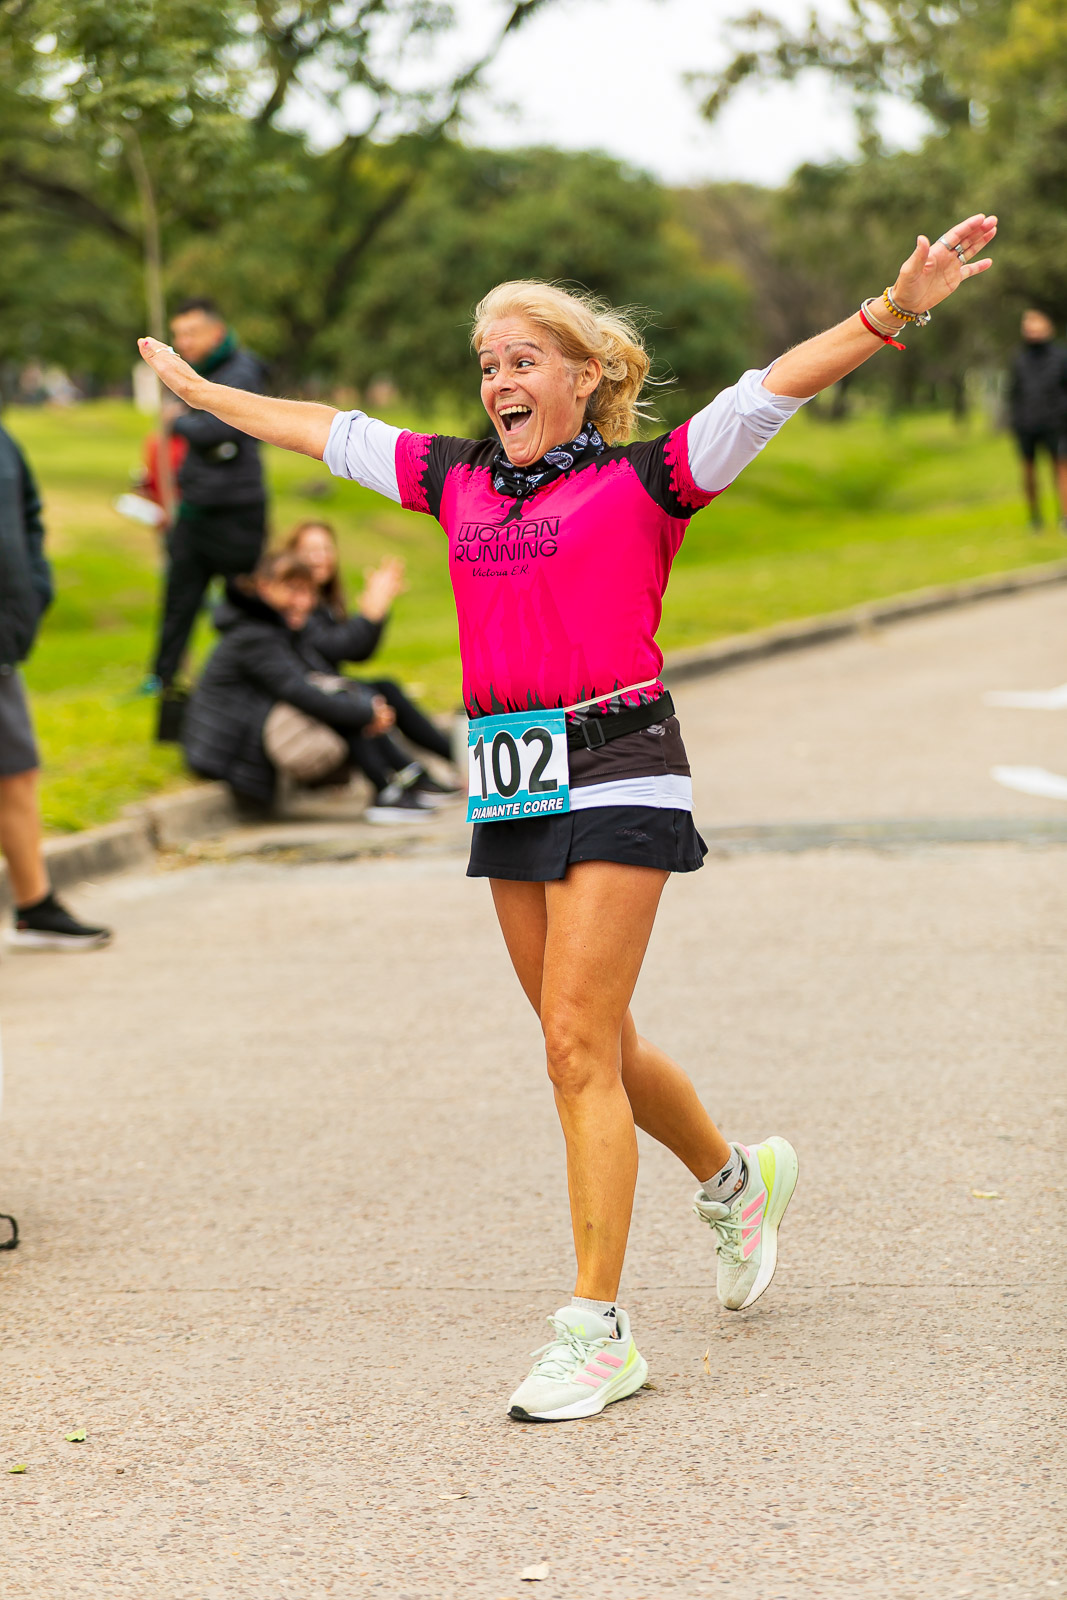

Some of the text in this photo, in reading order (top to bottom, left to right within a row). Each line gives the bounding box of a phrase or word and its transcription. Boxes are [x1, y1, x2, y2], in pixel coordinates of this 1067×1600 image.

[458, 519, 560, 542] WOMAN
[454, 540, 558, 563] RUNNING
[472, 567, 508, 577] Victoria
[473, 727, 559, 800] 102
[471, 798, 565, 820] DIAMANTE CORRE
